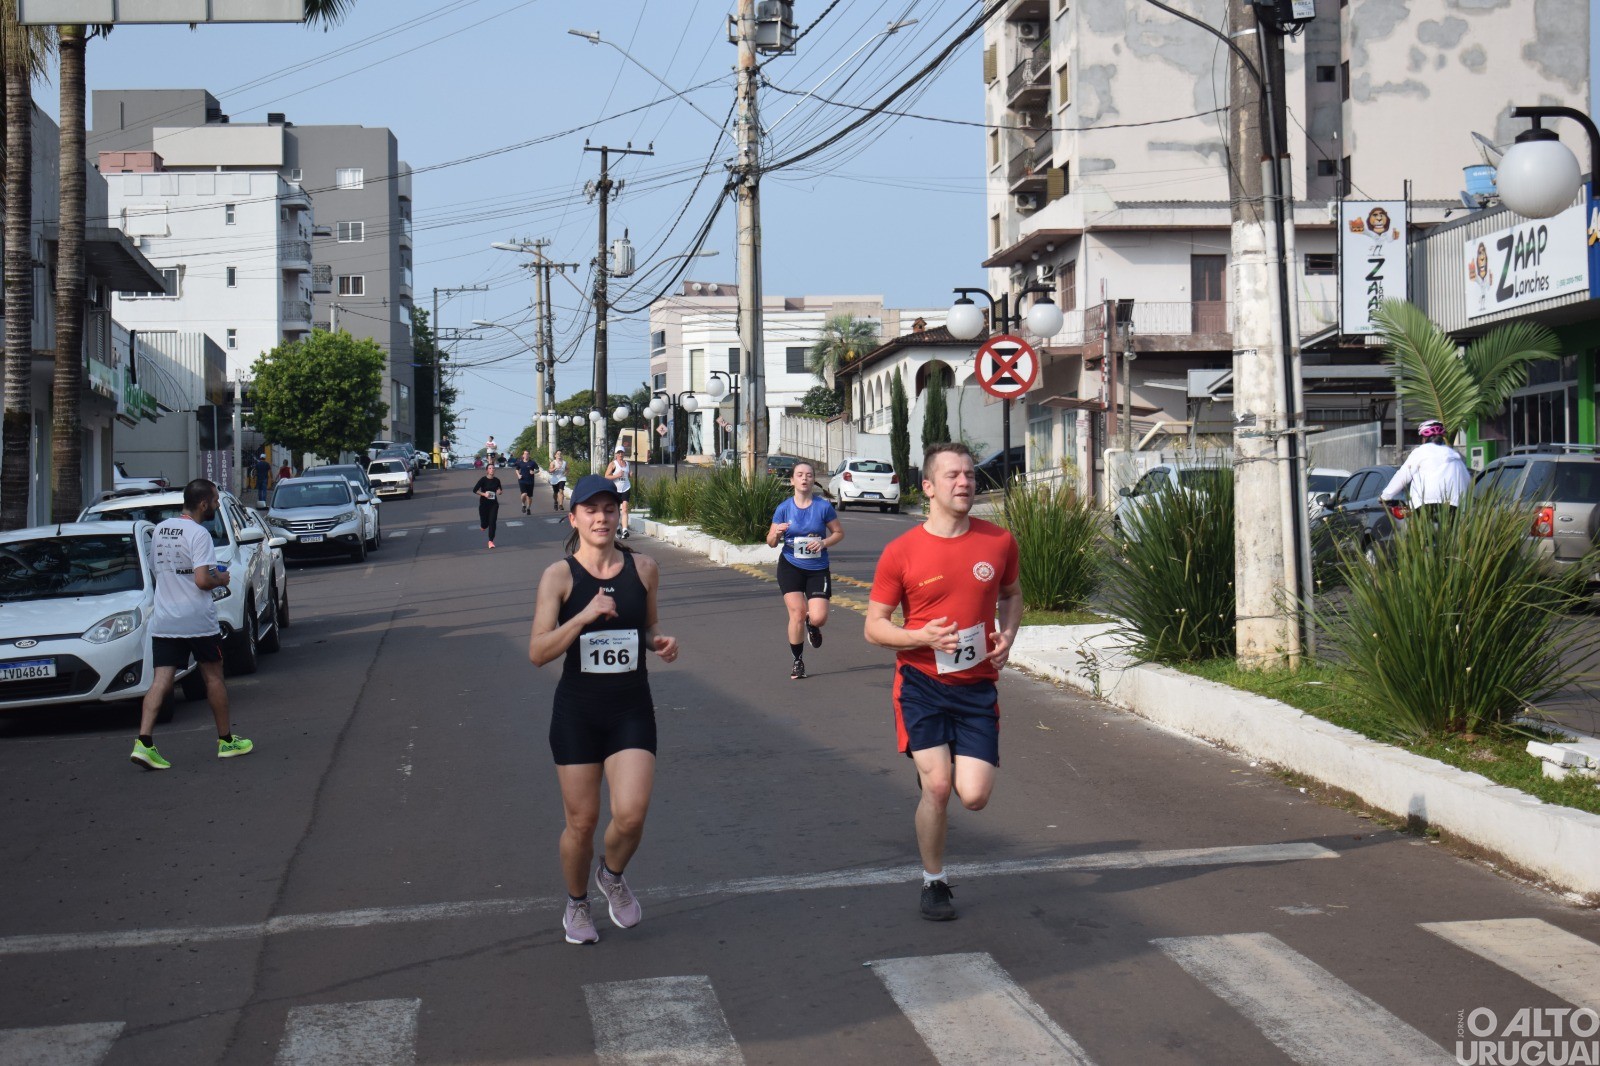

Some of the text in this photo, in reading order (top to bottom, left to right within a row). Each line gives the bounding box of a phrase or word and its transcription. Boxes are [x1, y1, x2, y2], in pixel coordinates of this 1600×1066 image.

[1496, 224, 1548, 303] ZAAP
[1514, 270, 1550, 298] Lanches
[158, 527, 184, 536] ATLETA
[589, 648, 631, 666] 166
[954, 645, 976, 664] 73
